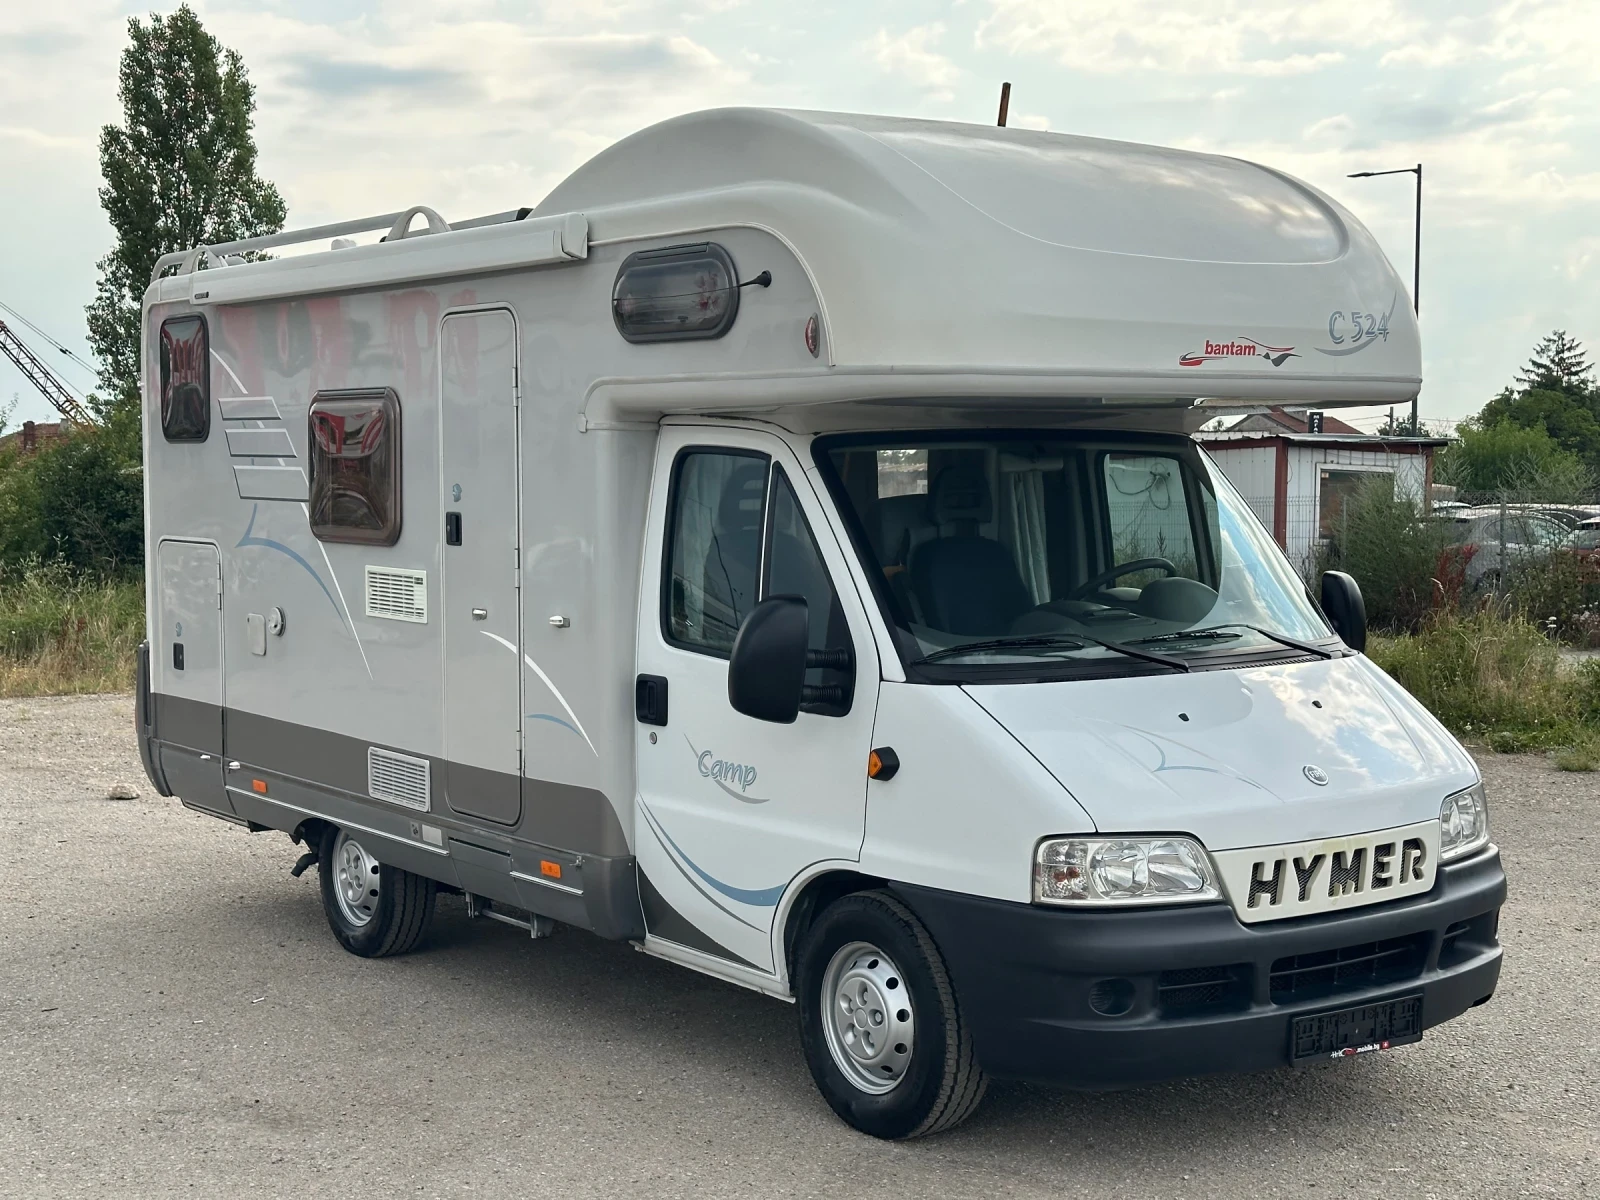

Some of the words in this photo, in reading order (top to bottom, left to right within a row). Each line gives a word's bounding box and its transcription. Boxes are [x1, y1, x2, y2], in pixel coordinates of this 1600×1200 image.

[1329, 310, 1345, 345] C
[1350, 311, 1390, 342] 524
[1204, 340, 1256, 356] bantam
[698, 749, 757, 792] Camp
[1247, 837, 1427, 909] HYMER
